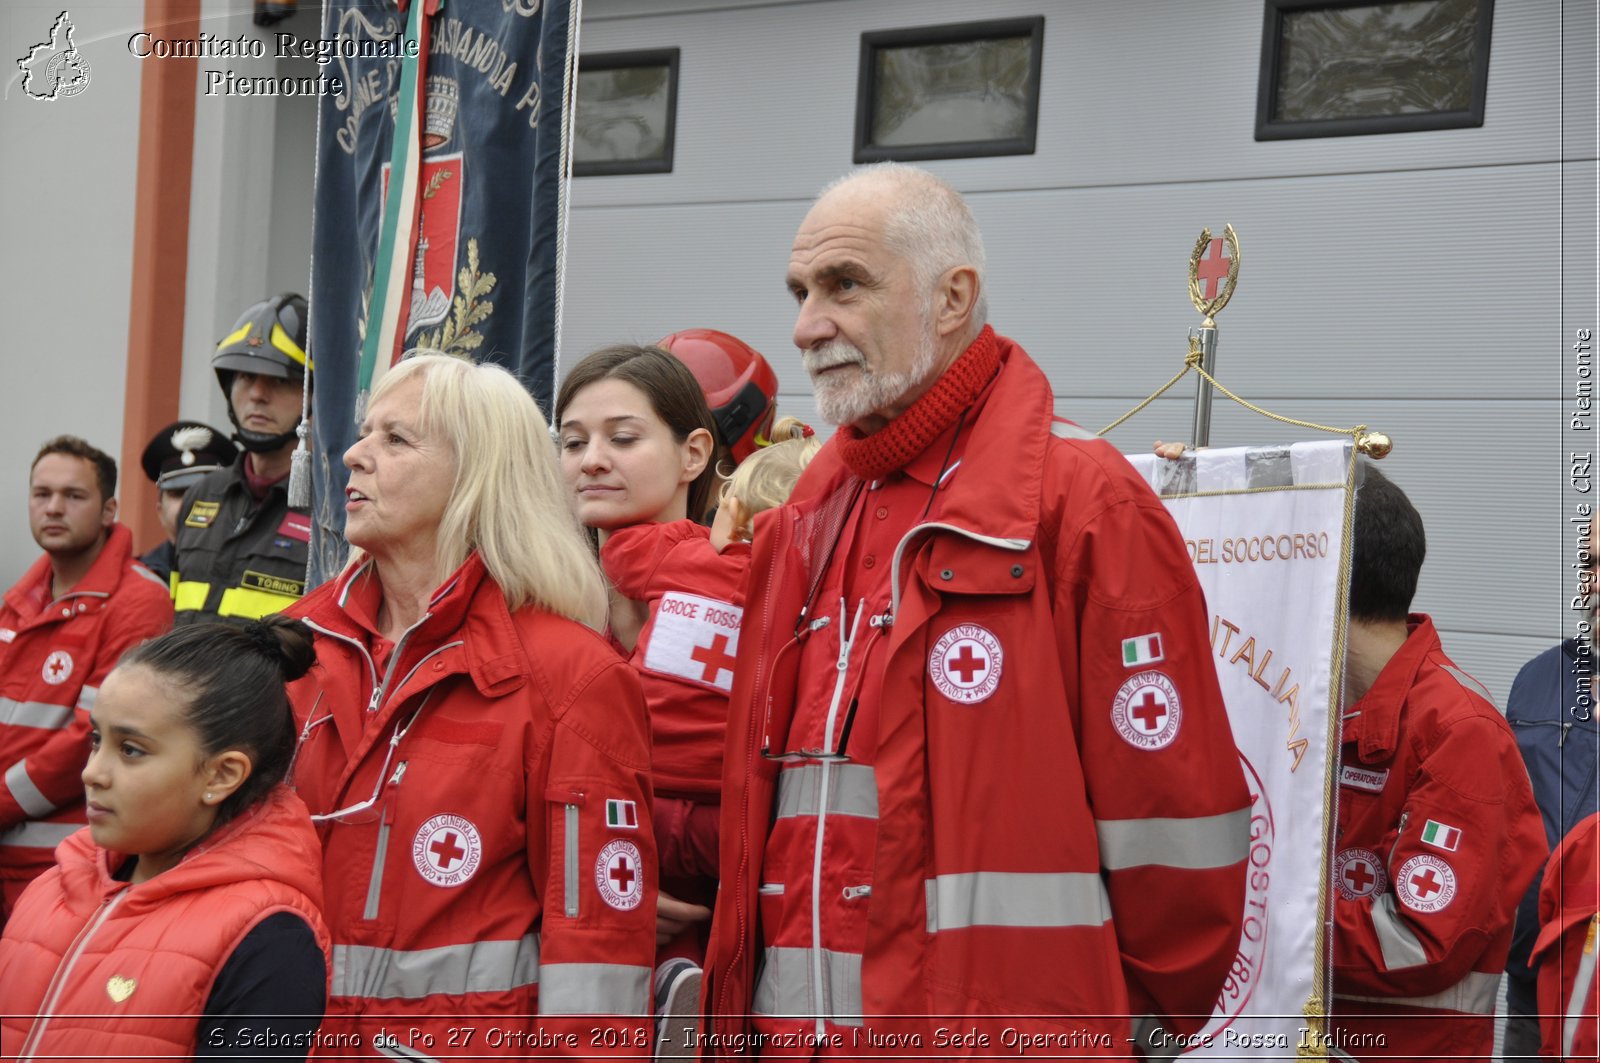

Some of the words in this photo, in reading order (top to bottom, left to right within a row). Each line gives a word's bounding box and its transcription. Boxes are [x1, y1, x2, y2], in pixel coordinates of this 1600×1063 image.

[1222, 532, 1329, 564] SOCCORSO
[256, 576, 299, 593] TORINO
[661, 599, 699, 619] CROCE
[939, 637, 950, 650] DI
[950, 626, 986, 643] GINEVRA
[931, 648, 963, 699] CONVENZIONE
[1132, 672, 1164, 689] GINEVRA
[1121, 683, 1133, 696] DI
[1114, 694, 1147, 746] CONVENZIONE
[429, 818, 440, 830] DI
[440, 815, 472, 836] GINEVRA
[468, 835, 479, 845] 22
[414, 826, 437, 880] CONVENZIONE
[462, 847, 479, 877] AGOSTO
[1397, 862, 1414, 905] CONVENZIONE
[1412, 856, 1421, 866] DI
[1421, 855, 1449, 875] GINEVRA
[1215, 949, 1255, 1016] 1864
